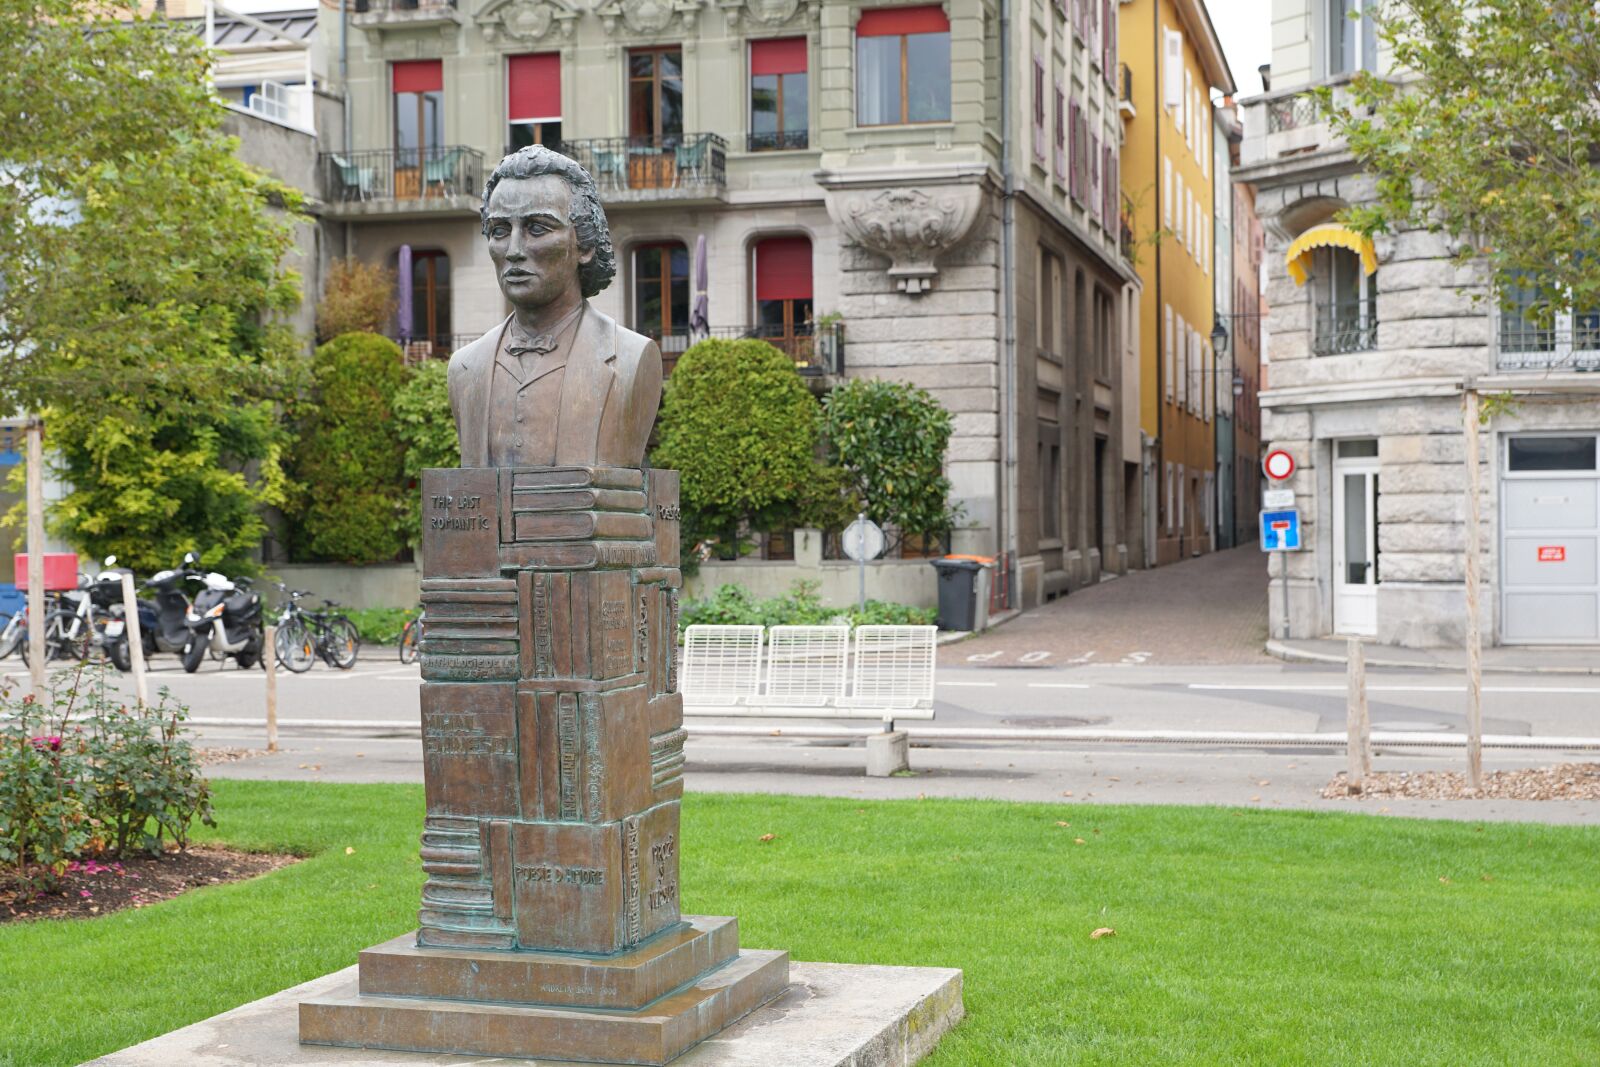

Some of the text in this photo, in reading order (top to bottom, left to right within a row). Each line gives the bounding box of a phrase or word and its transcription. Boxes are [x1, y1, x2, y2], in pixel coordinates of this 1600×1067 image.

[431, 495, 481, 508] THE LAST
[967, 651, 1153, 664] STOP
